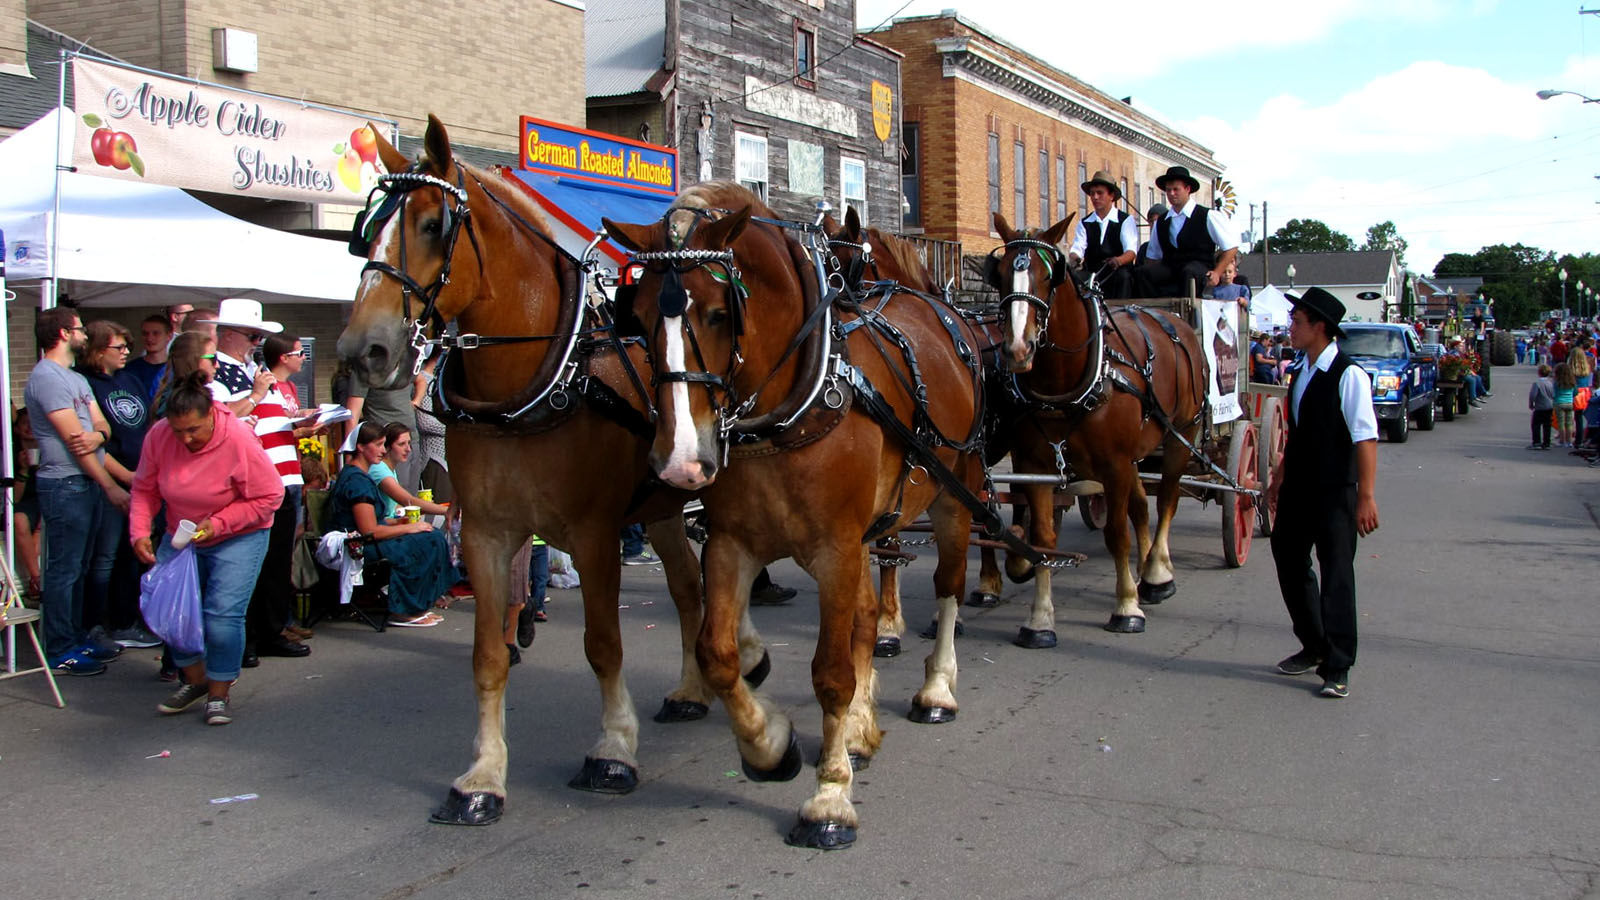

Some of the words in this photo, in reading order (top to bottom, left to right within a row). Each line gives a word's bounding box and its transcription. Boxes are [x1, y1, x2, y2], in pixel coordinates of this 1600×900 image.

[104, 82, 209, 129] Apple
[216, 99, 286, 140] Cider
[231, 144, 334, 192] Slushies
[527, 130, 577, 169] German
[579, 140, 624, 178] Roasted
[627, 151, 672, 187] Almonds
